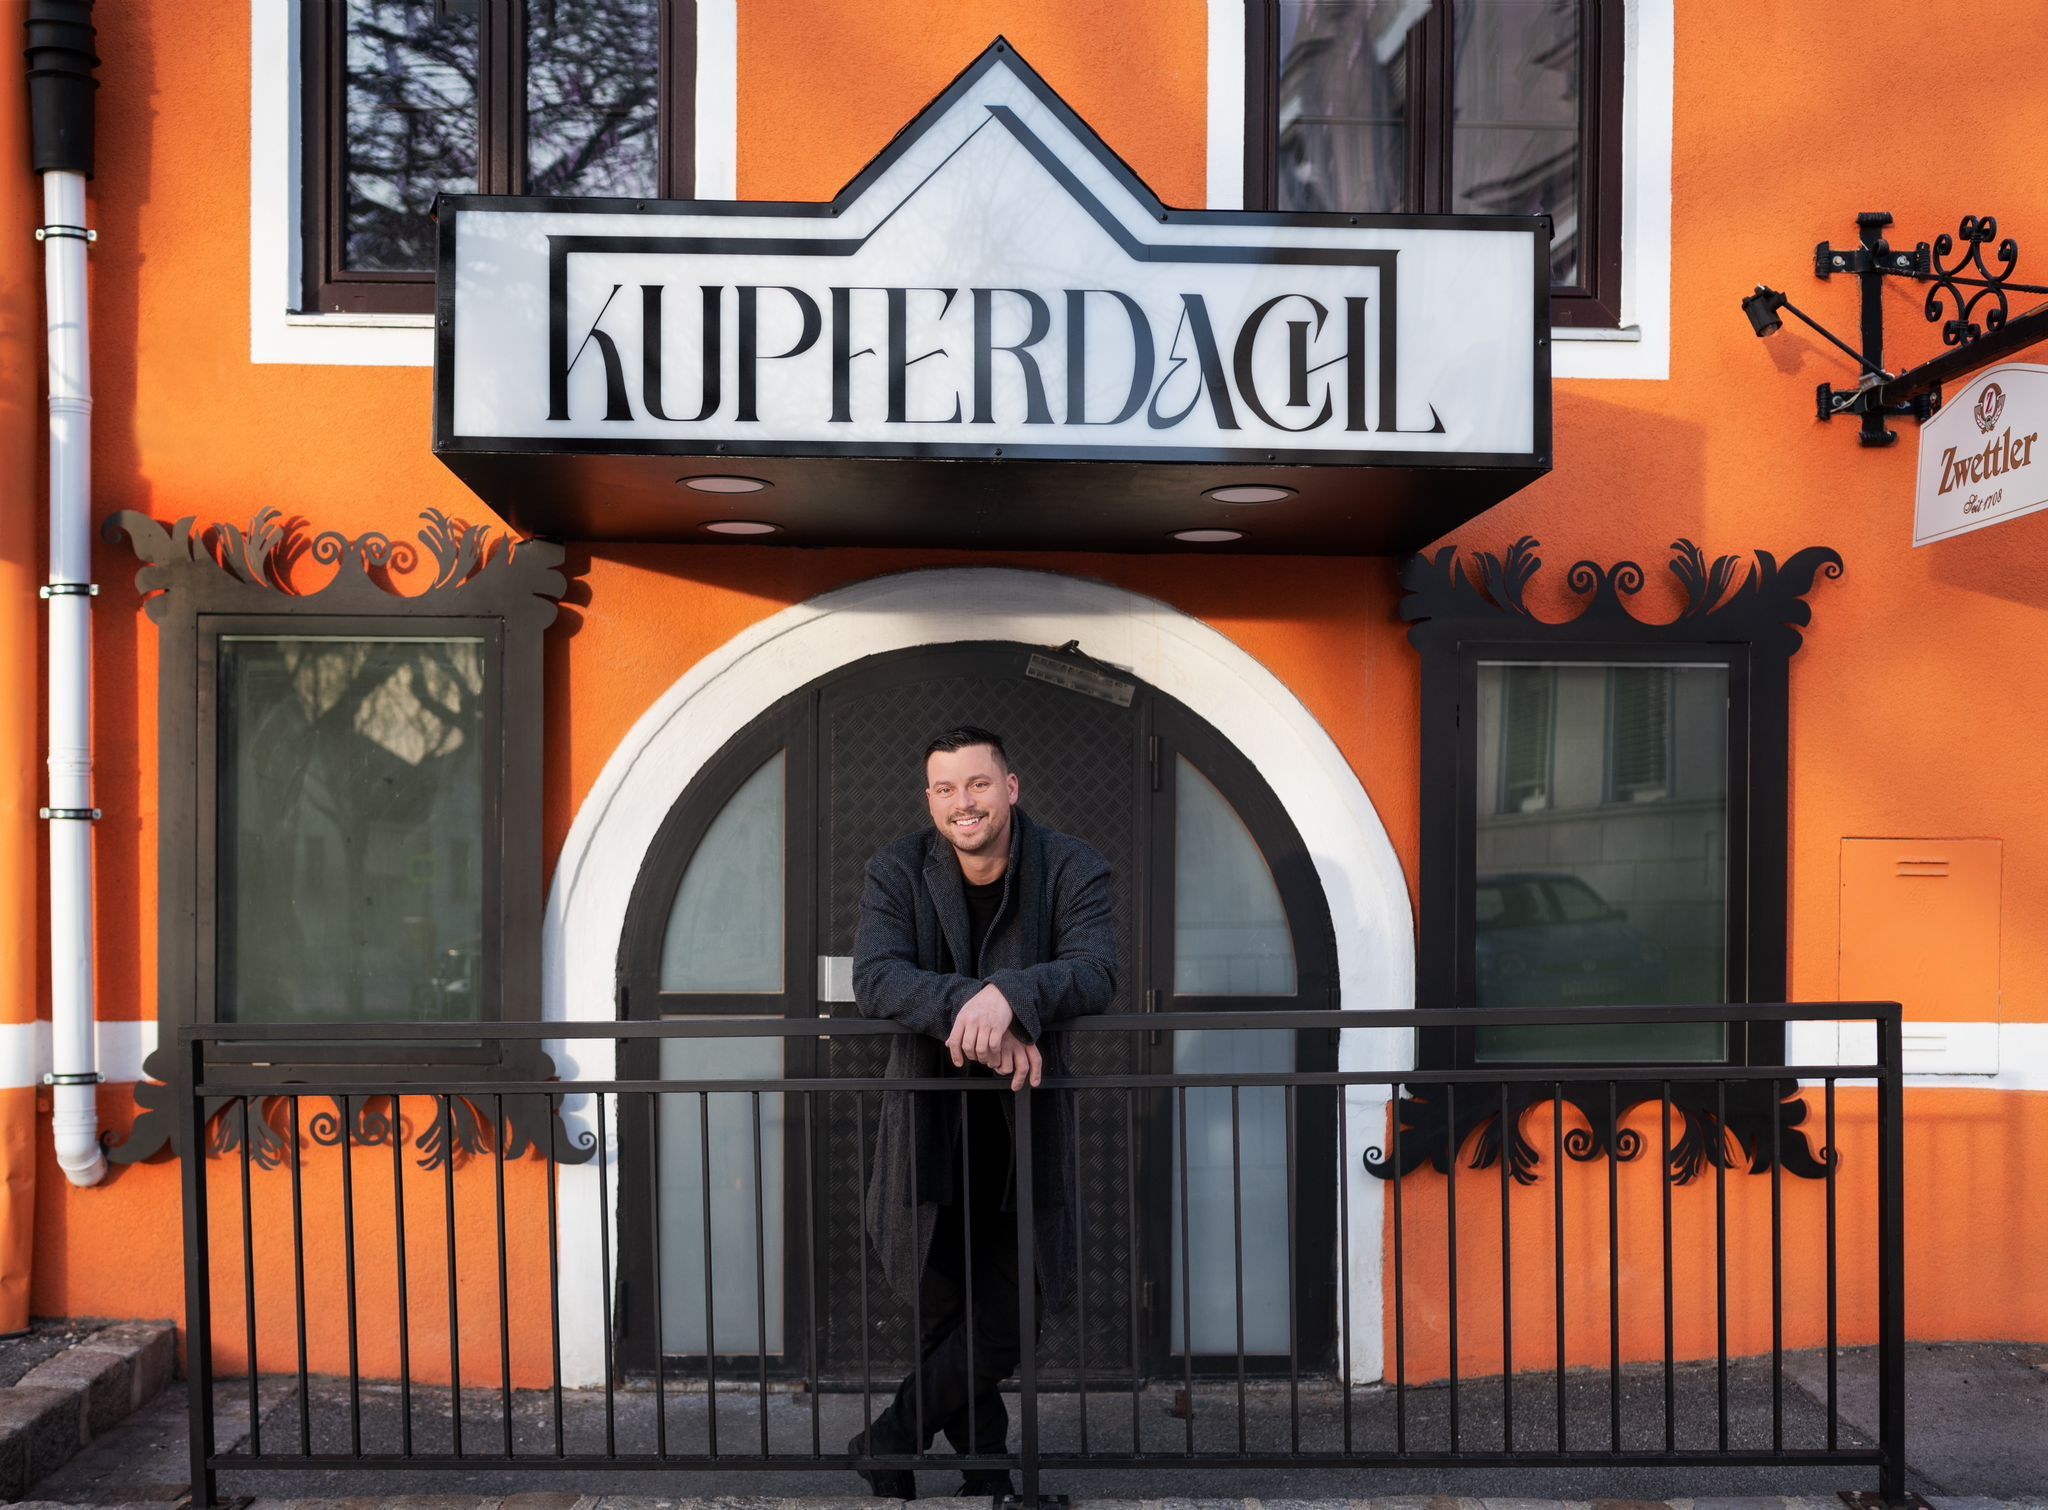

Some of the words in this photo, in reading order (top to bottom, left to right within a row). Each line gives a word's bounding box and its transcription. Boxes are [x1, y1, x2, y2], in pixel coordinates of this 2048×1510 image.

[546, 284, 1446, 435] KUPFERDACHL
[1984, 391, 1994, 414] Z
[1938, 426, 2038, 496] Zwettler
[1963, 494, 1984, 514] Seit
[1983, 488, 2003, 510] 1708
